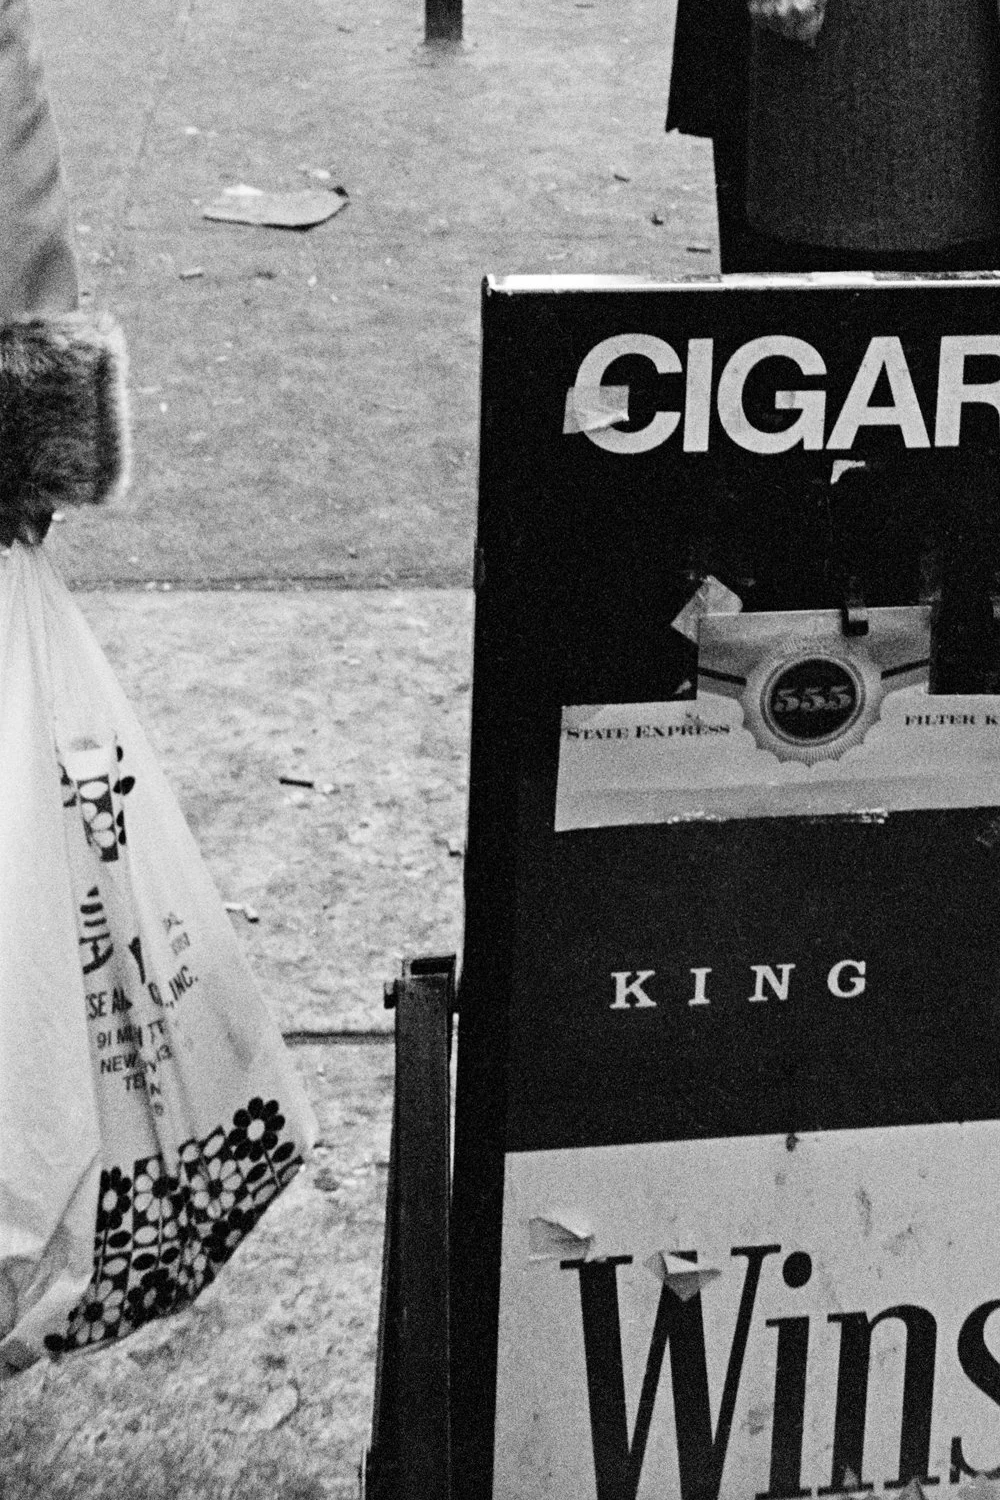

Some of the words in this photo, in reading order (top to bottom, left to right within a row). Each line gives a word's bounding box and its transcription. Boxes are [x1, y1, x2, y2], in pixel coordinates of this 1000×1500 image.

[773, 686, 853, 712] 555
[566, 726, 630, 741] STATE
[634, 721, 731, 739] EXPRESS
[904, 712, 976, 727] FILTER
[609, 958, 868, 1010] KING
[100, 1053, 137, 1075] NEW
